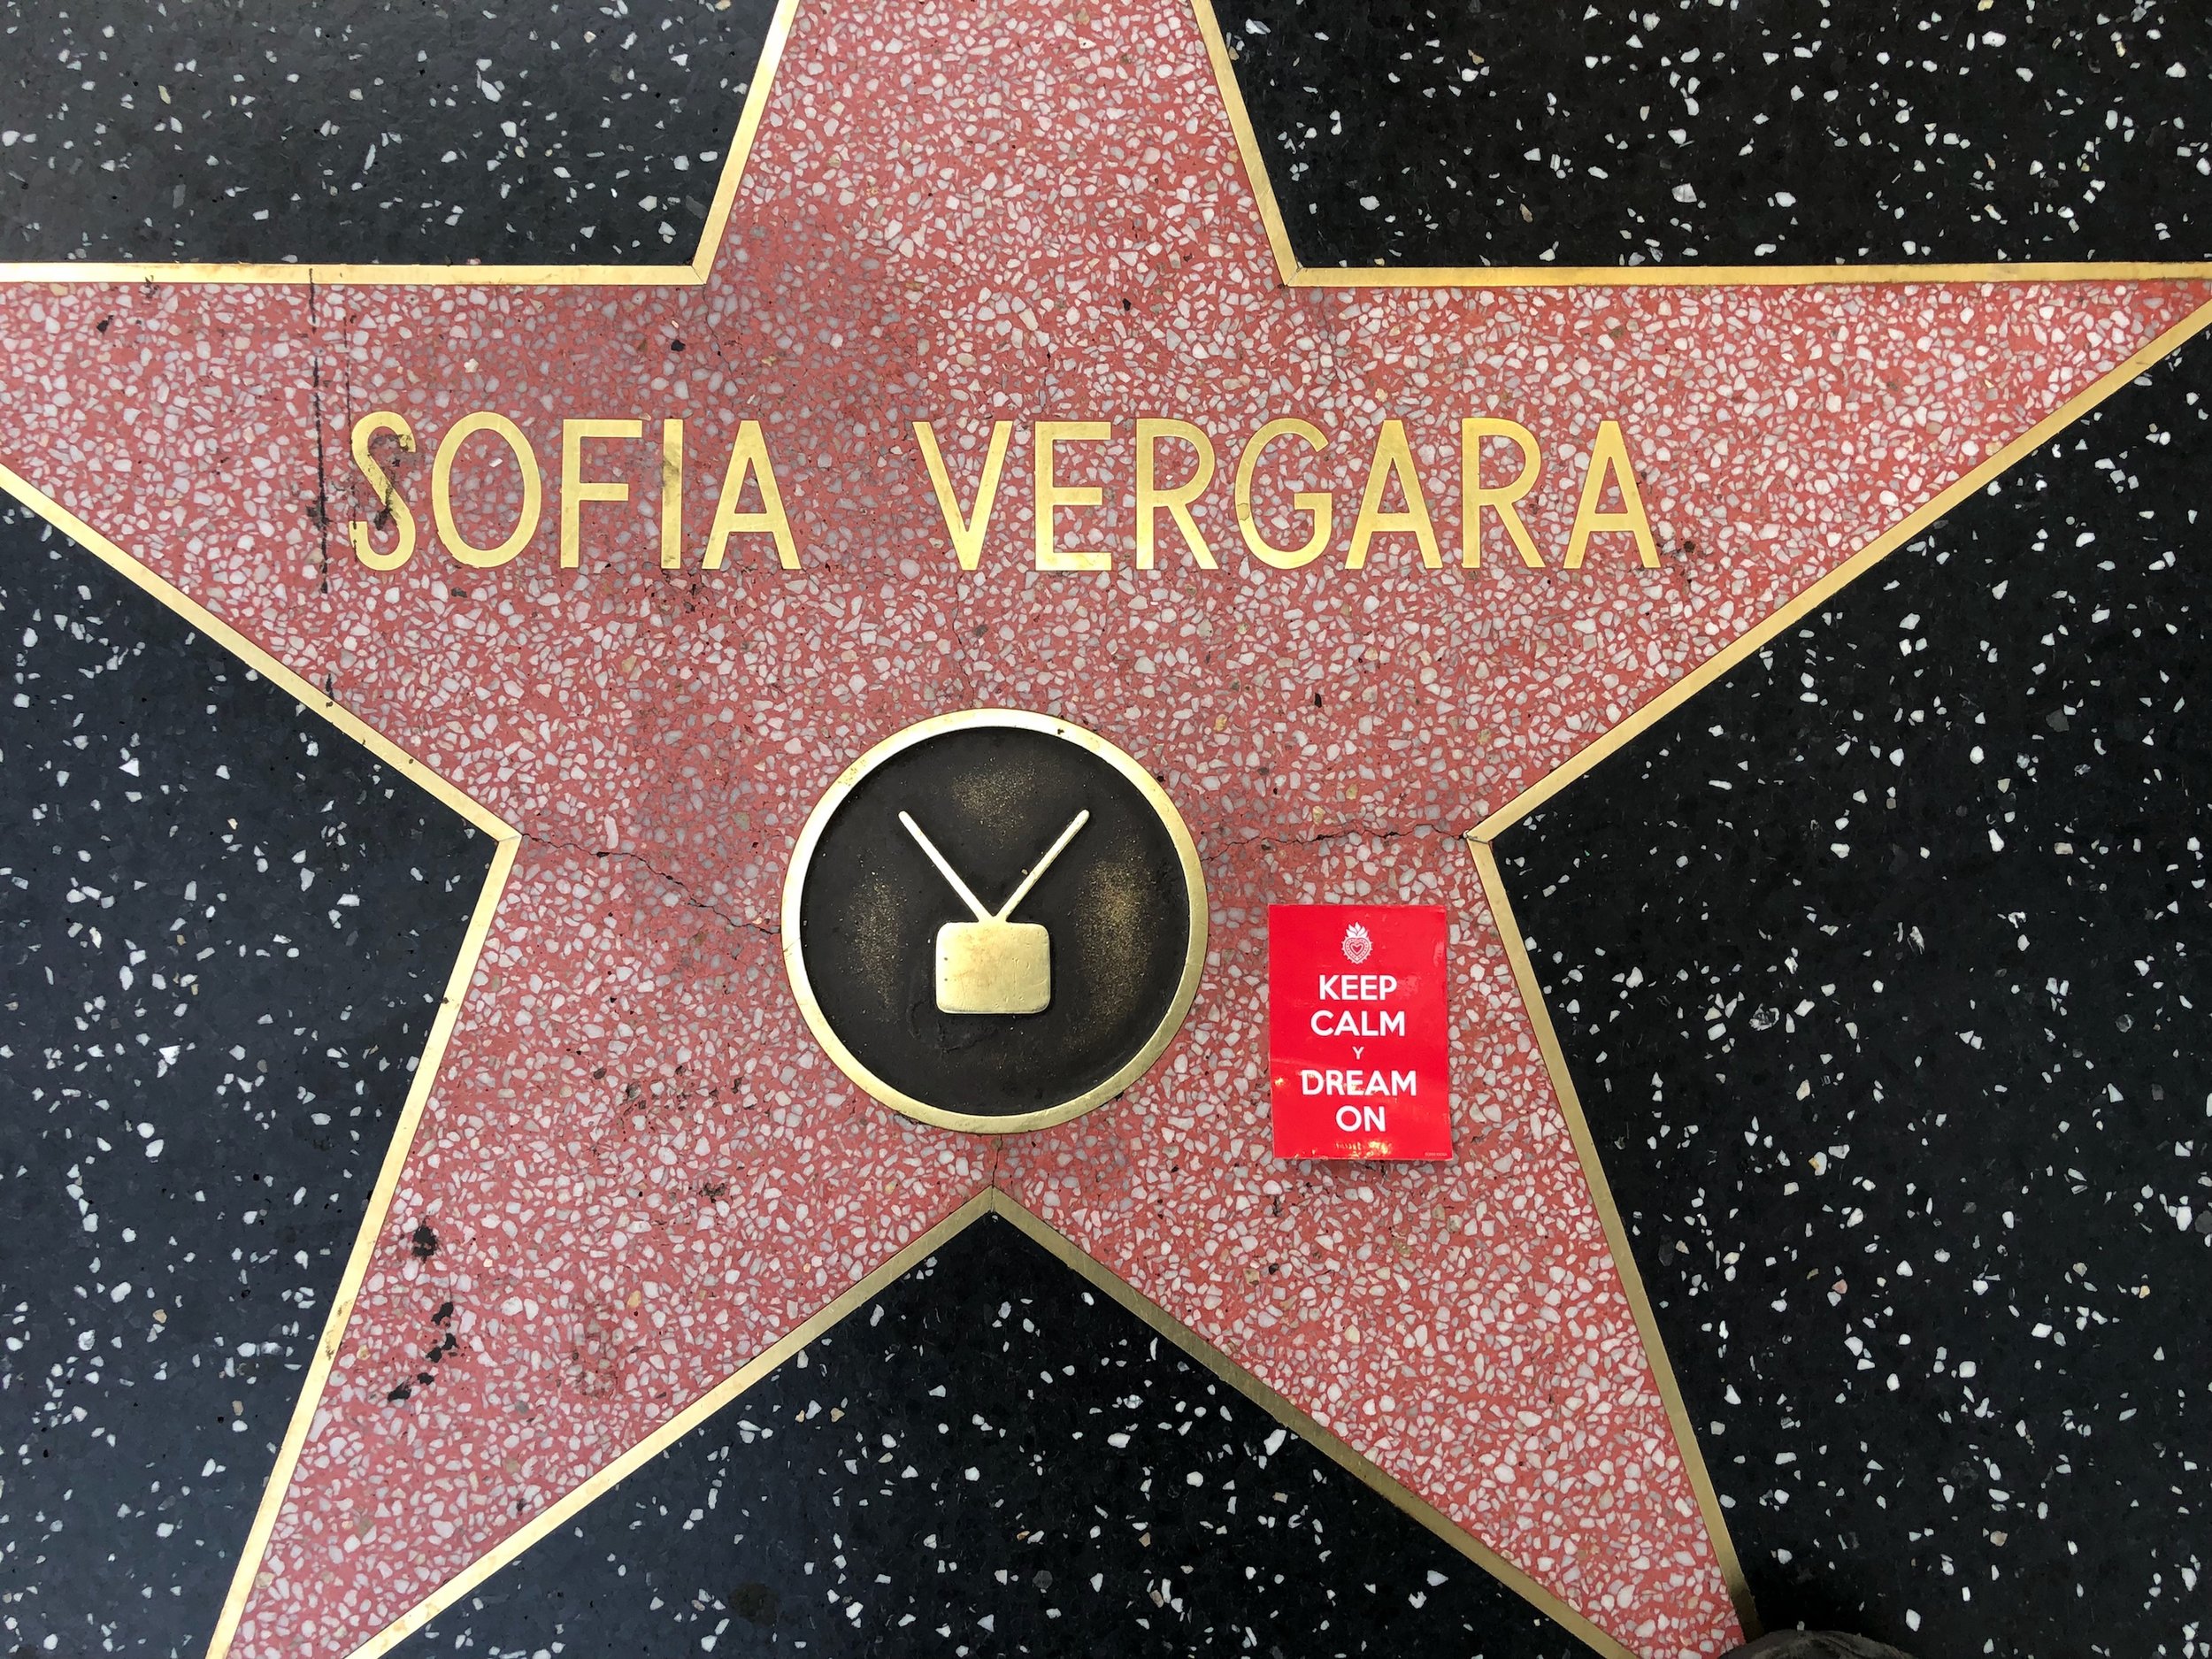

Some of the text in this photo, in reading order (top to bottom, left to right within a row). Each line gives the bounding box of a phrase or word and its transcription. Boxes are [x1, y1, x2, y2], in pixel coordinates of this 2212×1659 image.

[349, 411, 1661, 571] SOFIA VERGARA
[1318, 974, 1398, 1001] KEEP
[1310, 1010, 1405, 1036] CALM
[1352, 1046, 1364, 1059] Y
[1302, 1069, 1417, 1096] DREAM
[1335, 1105, 1386, 1132] ON
